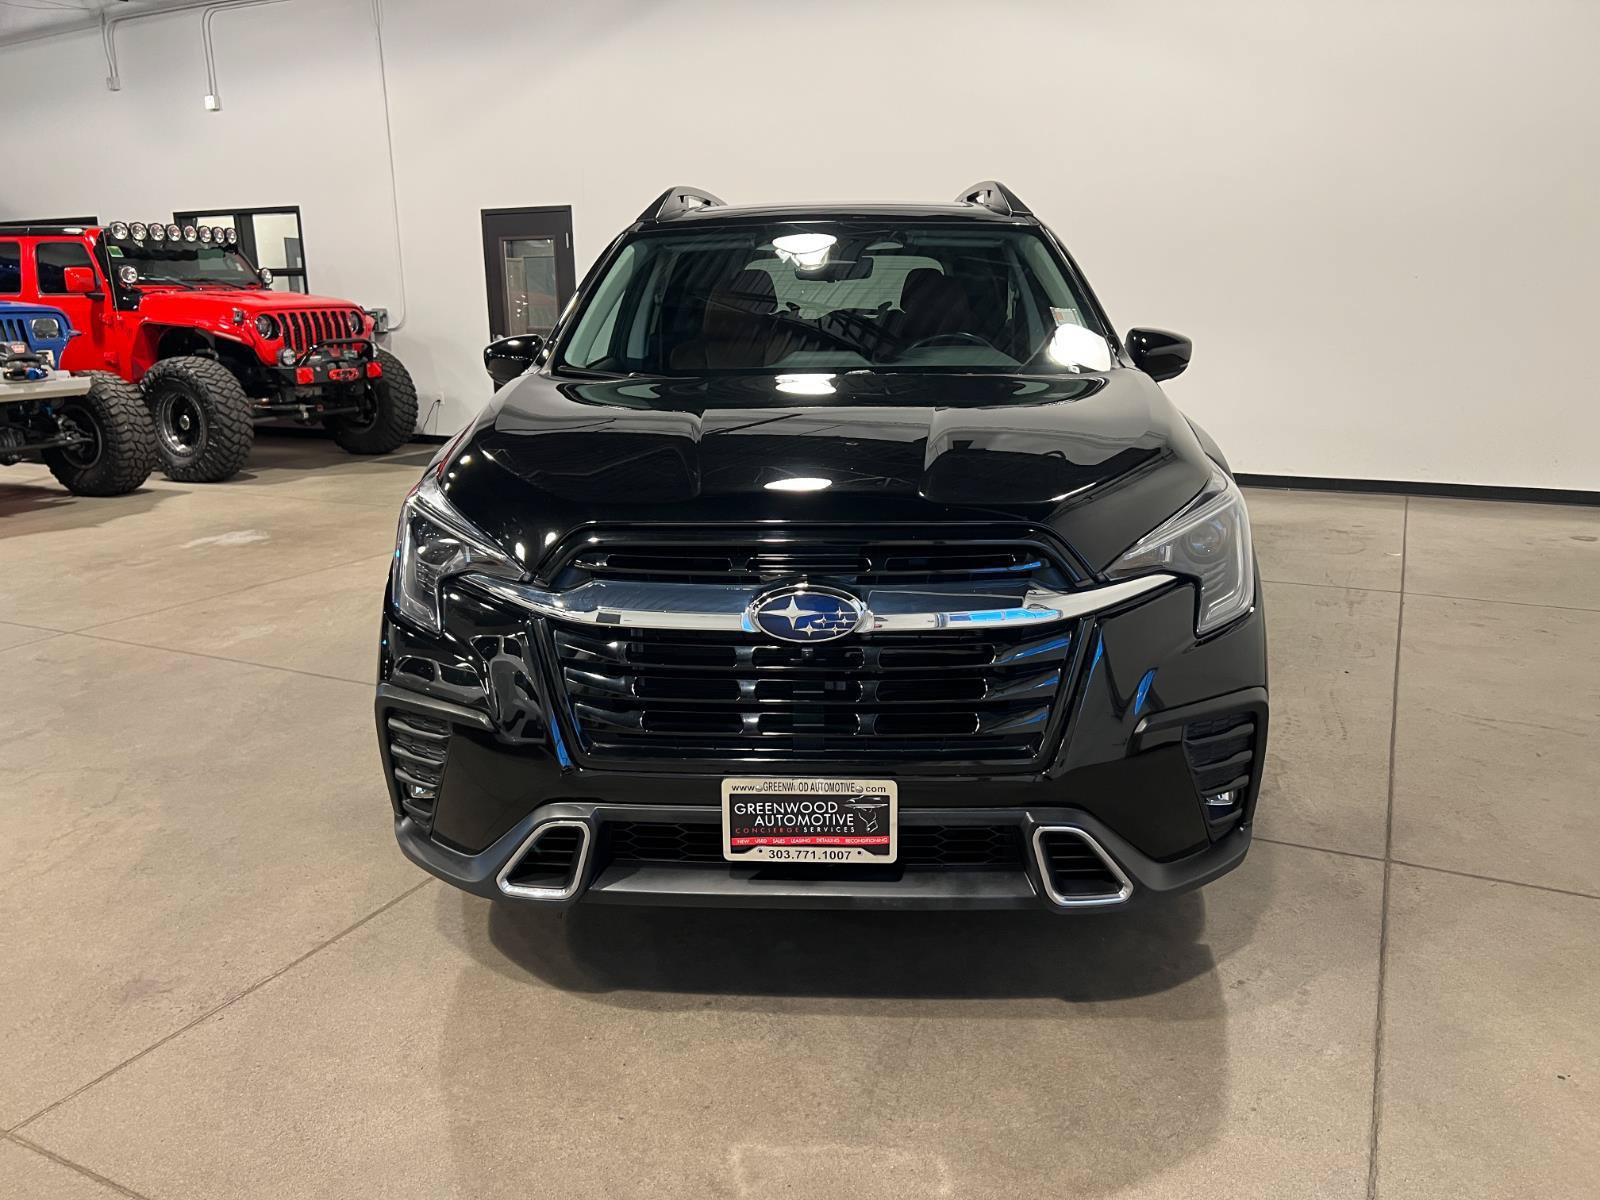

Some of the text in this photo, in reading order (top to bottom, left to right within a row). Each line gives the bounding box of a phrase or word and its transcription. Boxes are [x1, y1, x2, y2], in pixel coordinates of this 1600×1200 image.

[810, 782, 855, 793] AUTOMOTIVE
[734, 801, 838, 815] GREENWOOD
[754, 814, 854, 827] AUTOMOTIVE
[768, 849, 852, 860] 303.771.1007
